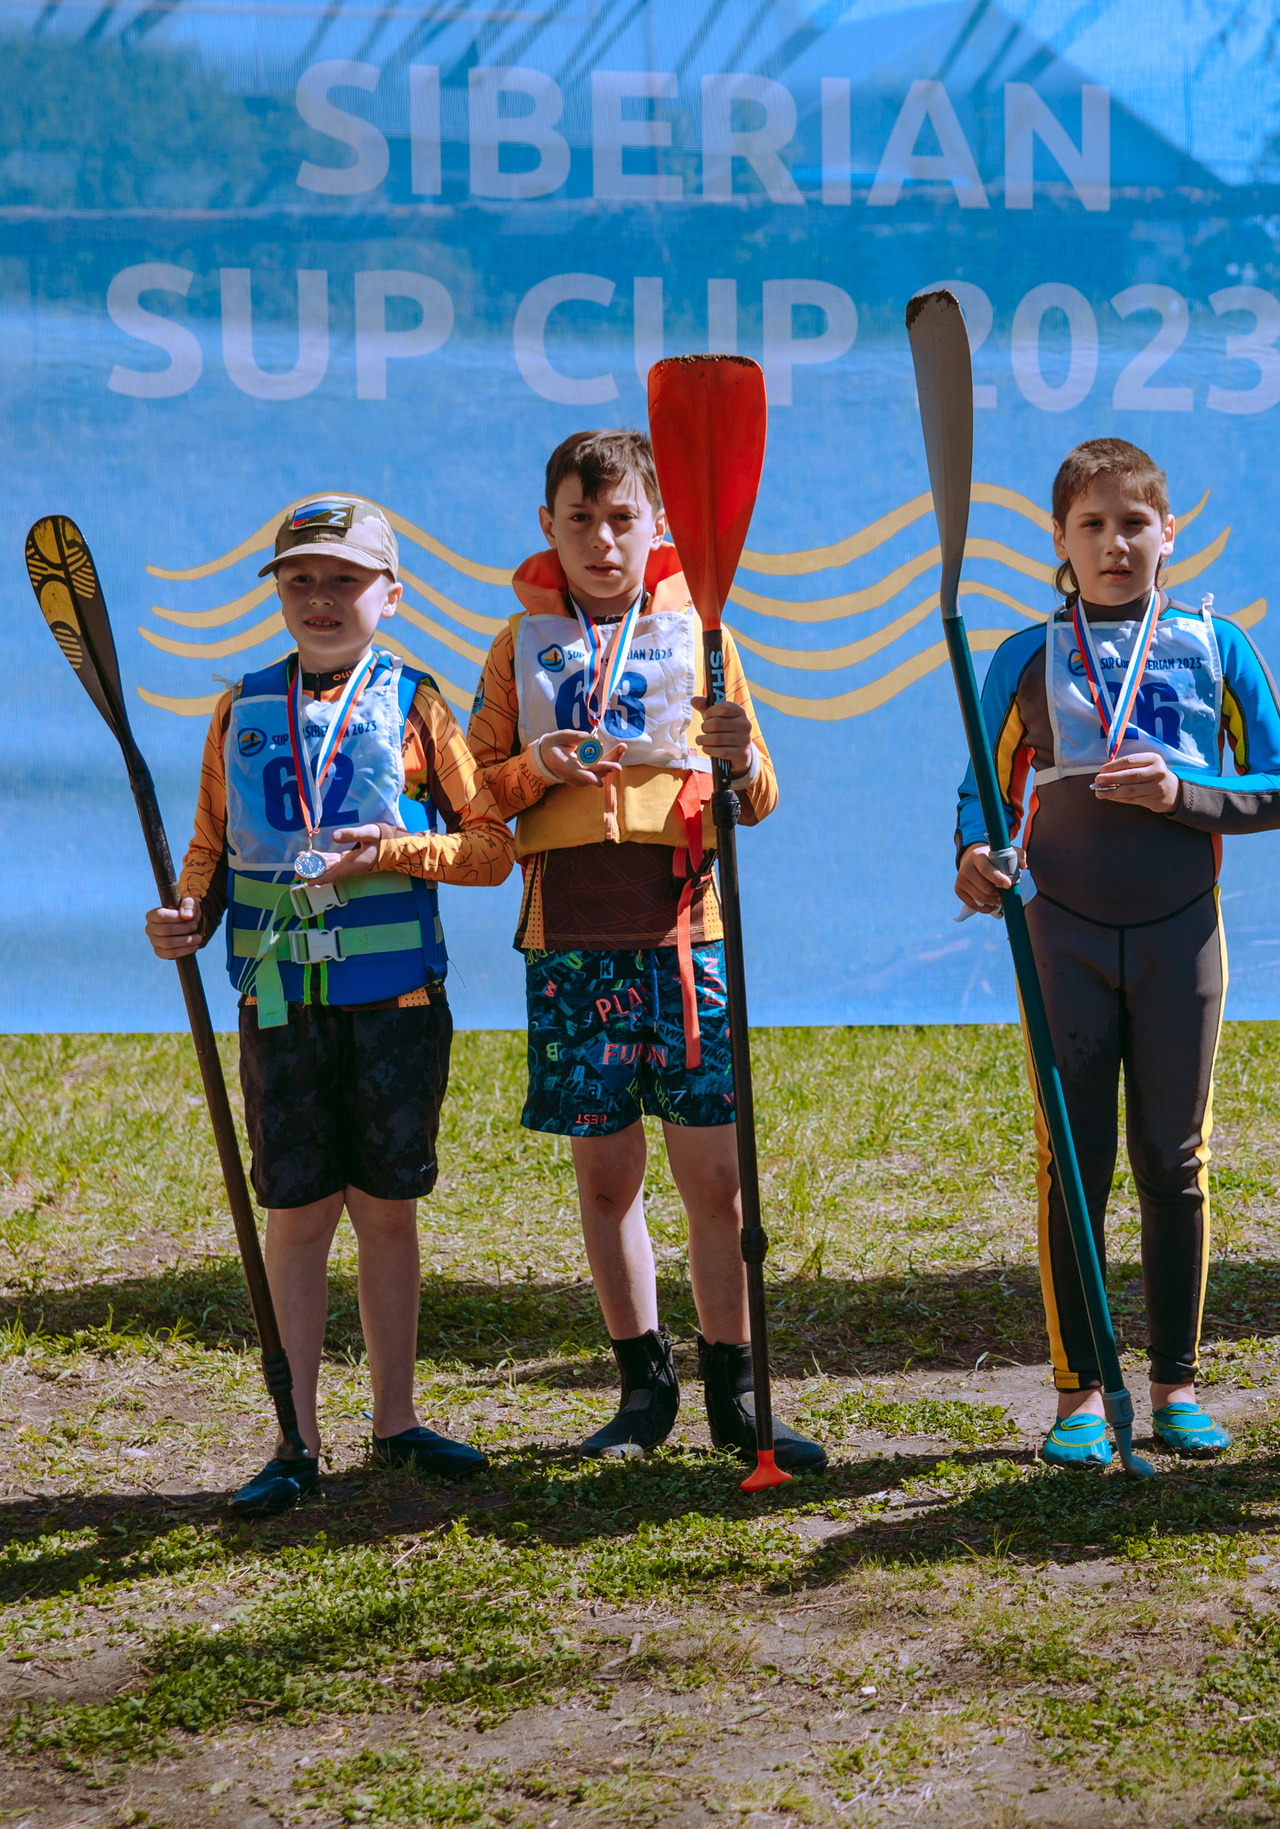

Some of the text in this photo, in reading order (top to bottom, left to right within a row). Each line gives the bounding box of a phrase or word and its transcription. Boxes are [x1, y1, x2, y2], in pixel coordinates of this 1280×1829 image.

[295, 58, 1112, 213] SIBERIAN
[106, 262, 455, 401] SUP
[512, 272, 858, 407] CUP
[328, 510, 348, 526] Z
[648, 648, 673, 660] 2023
[1101, 657, 1115, 670] SUP
[1177, 657, 1202, 670] 2023
[555, 670, 648, 739] 63
[271, 733, 289, 747] SUP
[351, 720, 378, 736] 2023
[263, 752, 360, 832] 62
